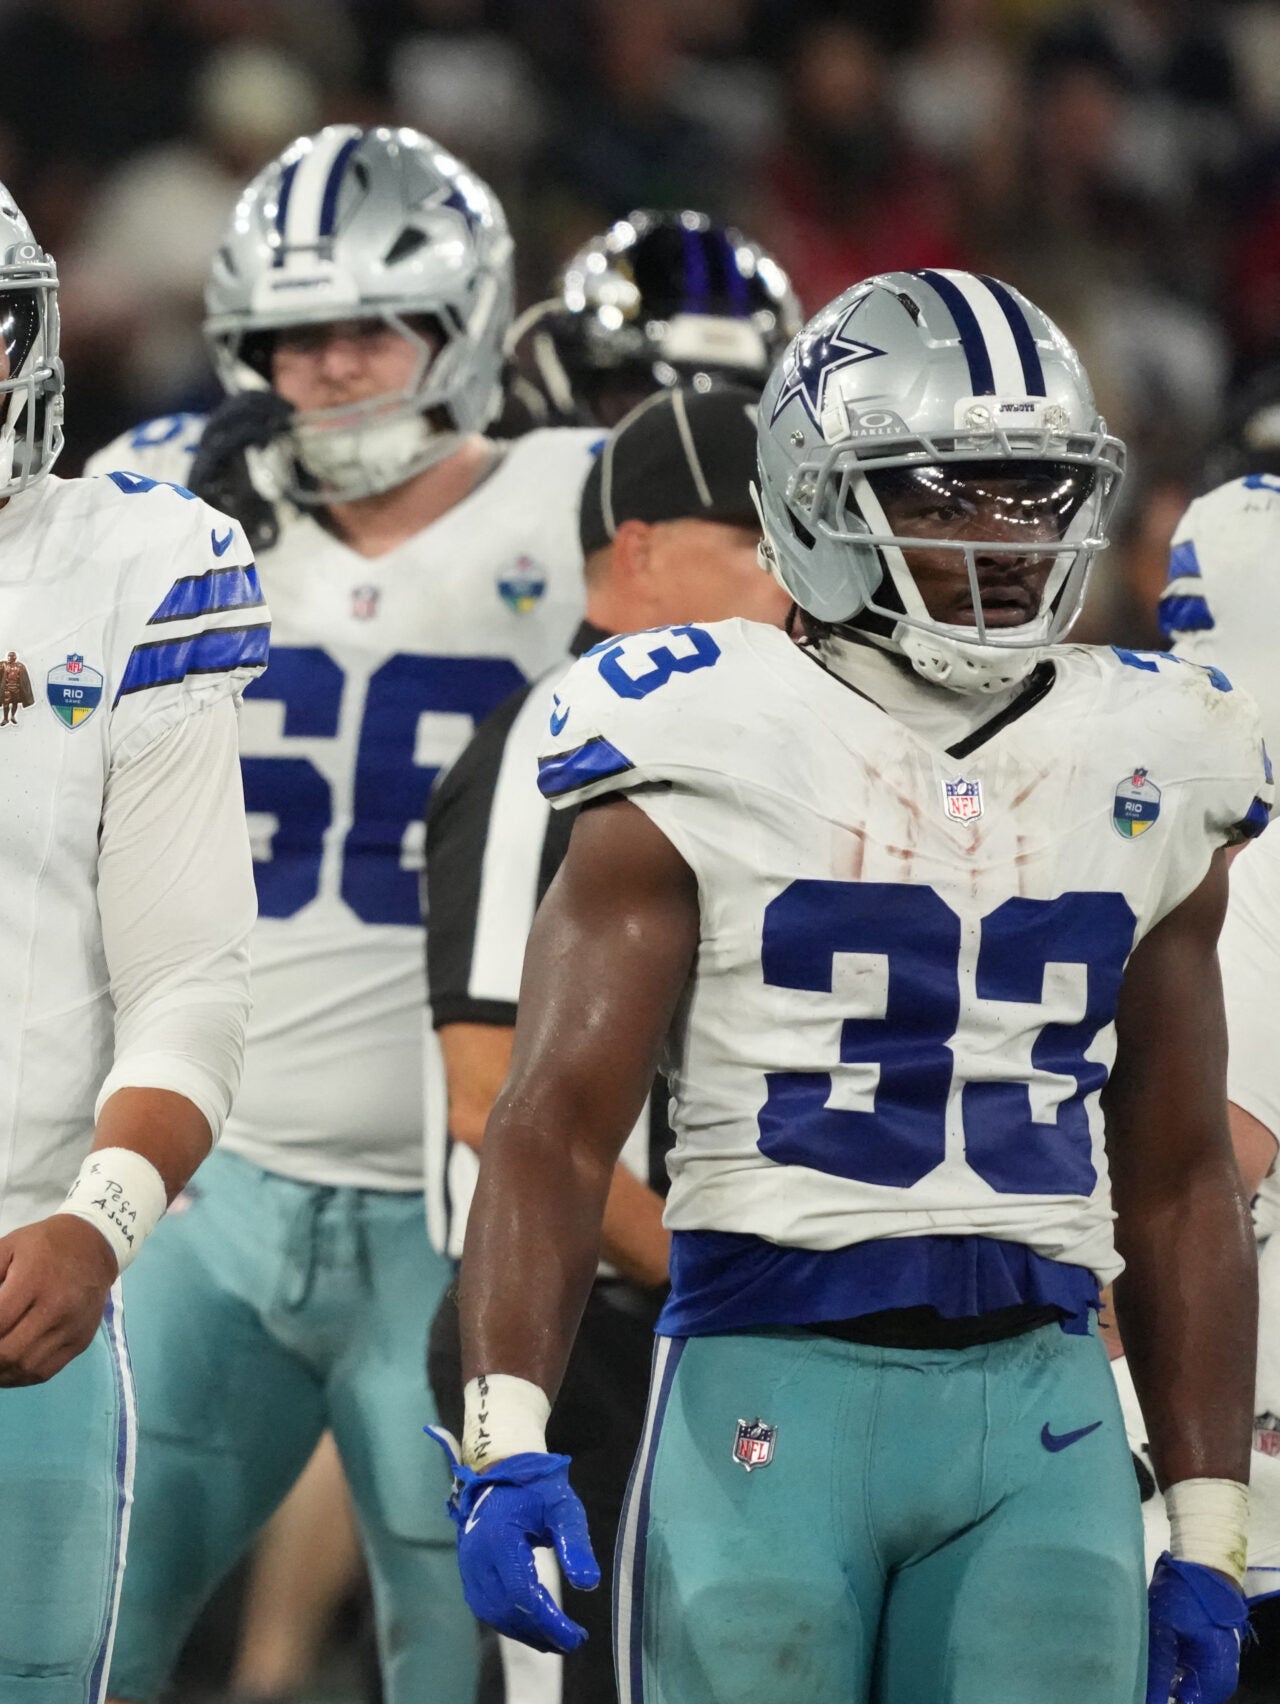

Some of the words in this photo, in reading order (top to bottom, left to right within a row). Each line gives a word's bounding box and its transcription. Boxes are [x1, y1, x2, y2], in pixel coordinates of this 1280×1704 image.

[852, 426, 902, 438] OAKLEY
[63, 688, 84, 699] RIO
[950, 797, 979, 816] NFL
[1125, 801, 1143, 813] RIO
[757, 879, 1137, 1197] 33
[739, 1440, 766, 1461] NFL
